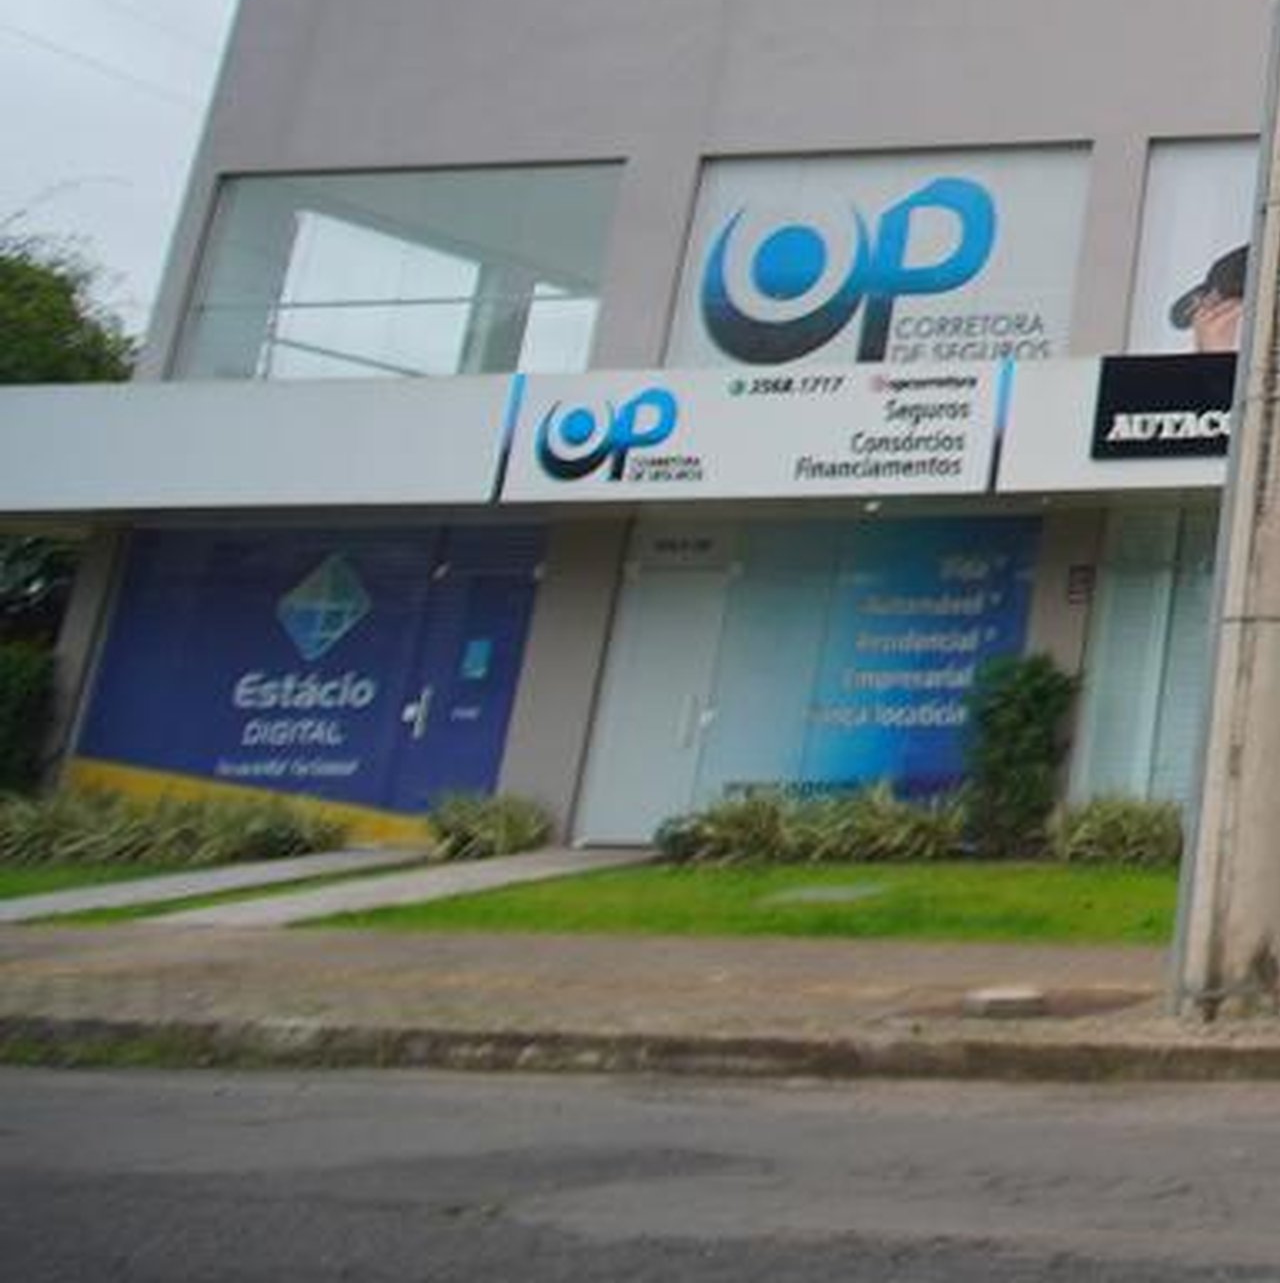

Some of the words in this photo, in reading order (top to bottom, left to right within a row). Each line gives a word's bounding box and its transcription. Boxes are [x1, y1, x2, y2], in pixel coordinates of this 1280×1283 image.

[896, 314, 1045, 340] CORRETORA
[884, 399, 970, 426] Seguros
[851, 431, 965, 453] Consórcios
[794, 455, 963, 481] Financiamentos
[233, 669, 375, 710] Estácio
[241, 719, 343, 746] DIGITAL
